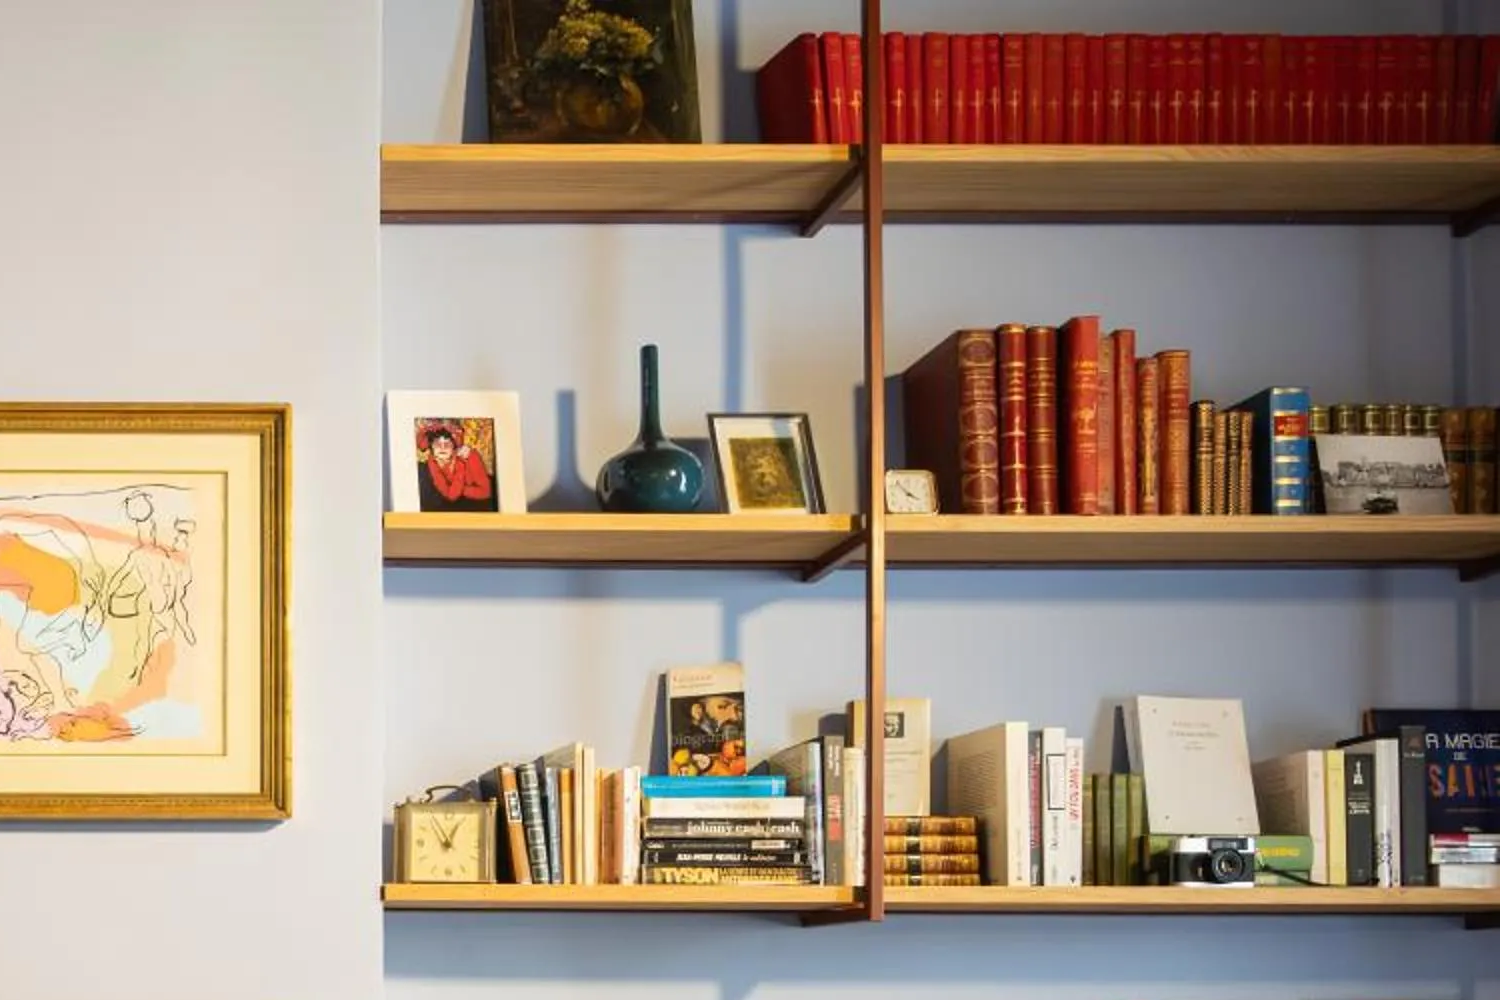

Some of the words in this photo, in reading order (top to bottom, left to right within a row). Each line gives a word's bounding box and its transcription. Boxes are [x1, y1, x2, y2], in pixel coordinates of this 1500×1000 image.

[687, 821, 733, 835] johnny
[771, 821, 800, 833] cash
[661, 867, 719, 884] TYSON
